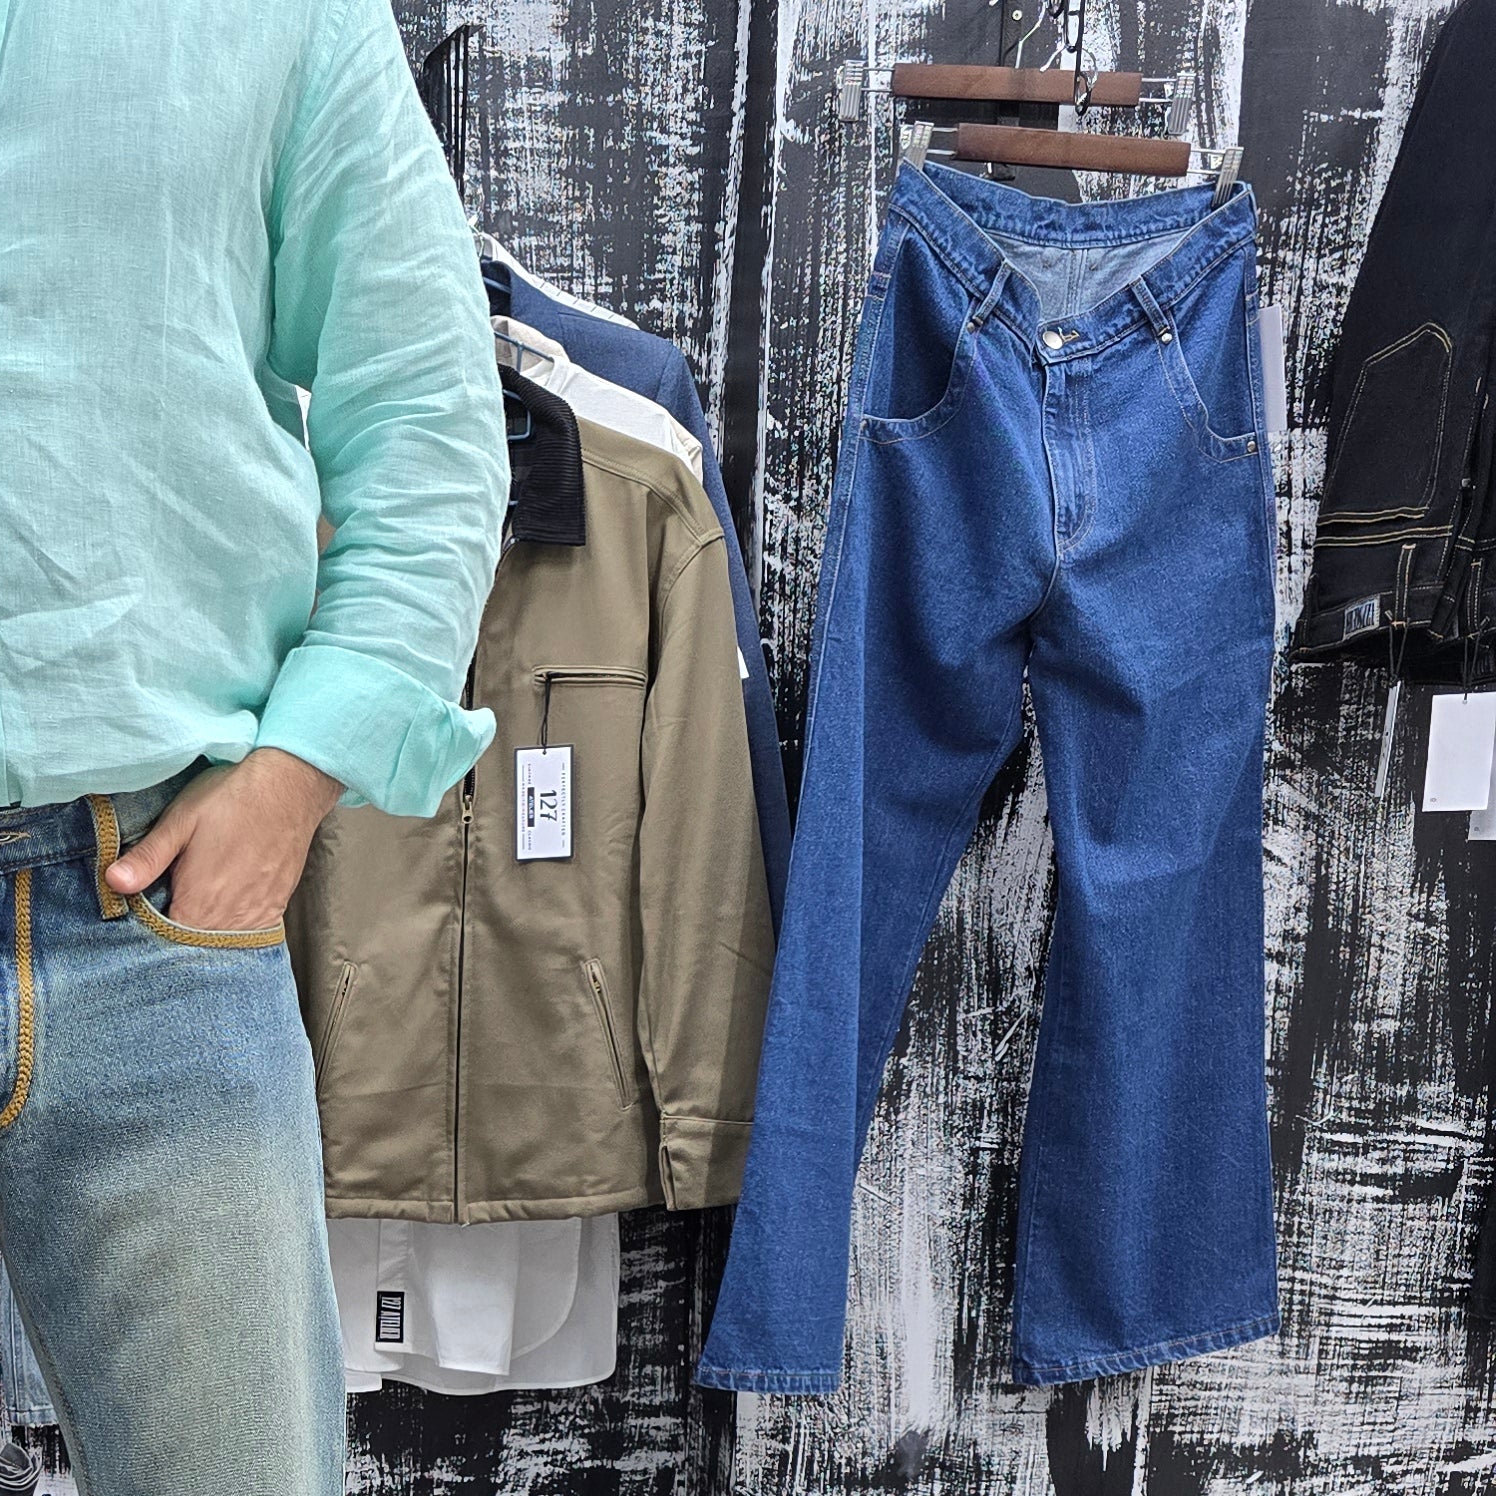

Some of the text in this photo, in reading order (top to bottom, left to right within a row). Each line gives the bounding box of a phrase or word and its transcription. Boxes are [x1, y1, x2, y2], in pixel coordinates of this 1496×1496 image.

[540, 789, 558, 821] 127
[379, 1296, 401, 1339] 127 ATELIER
